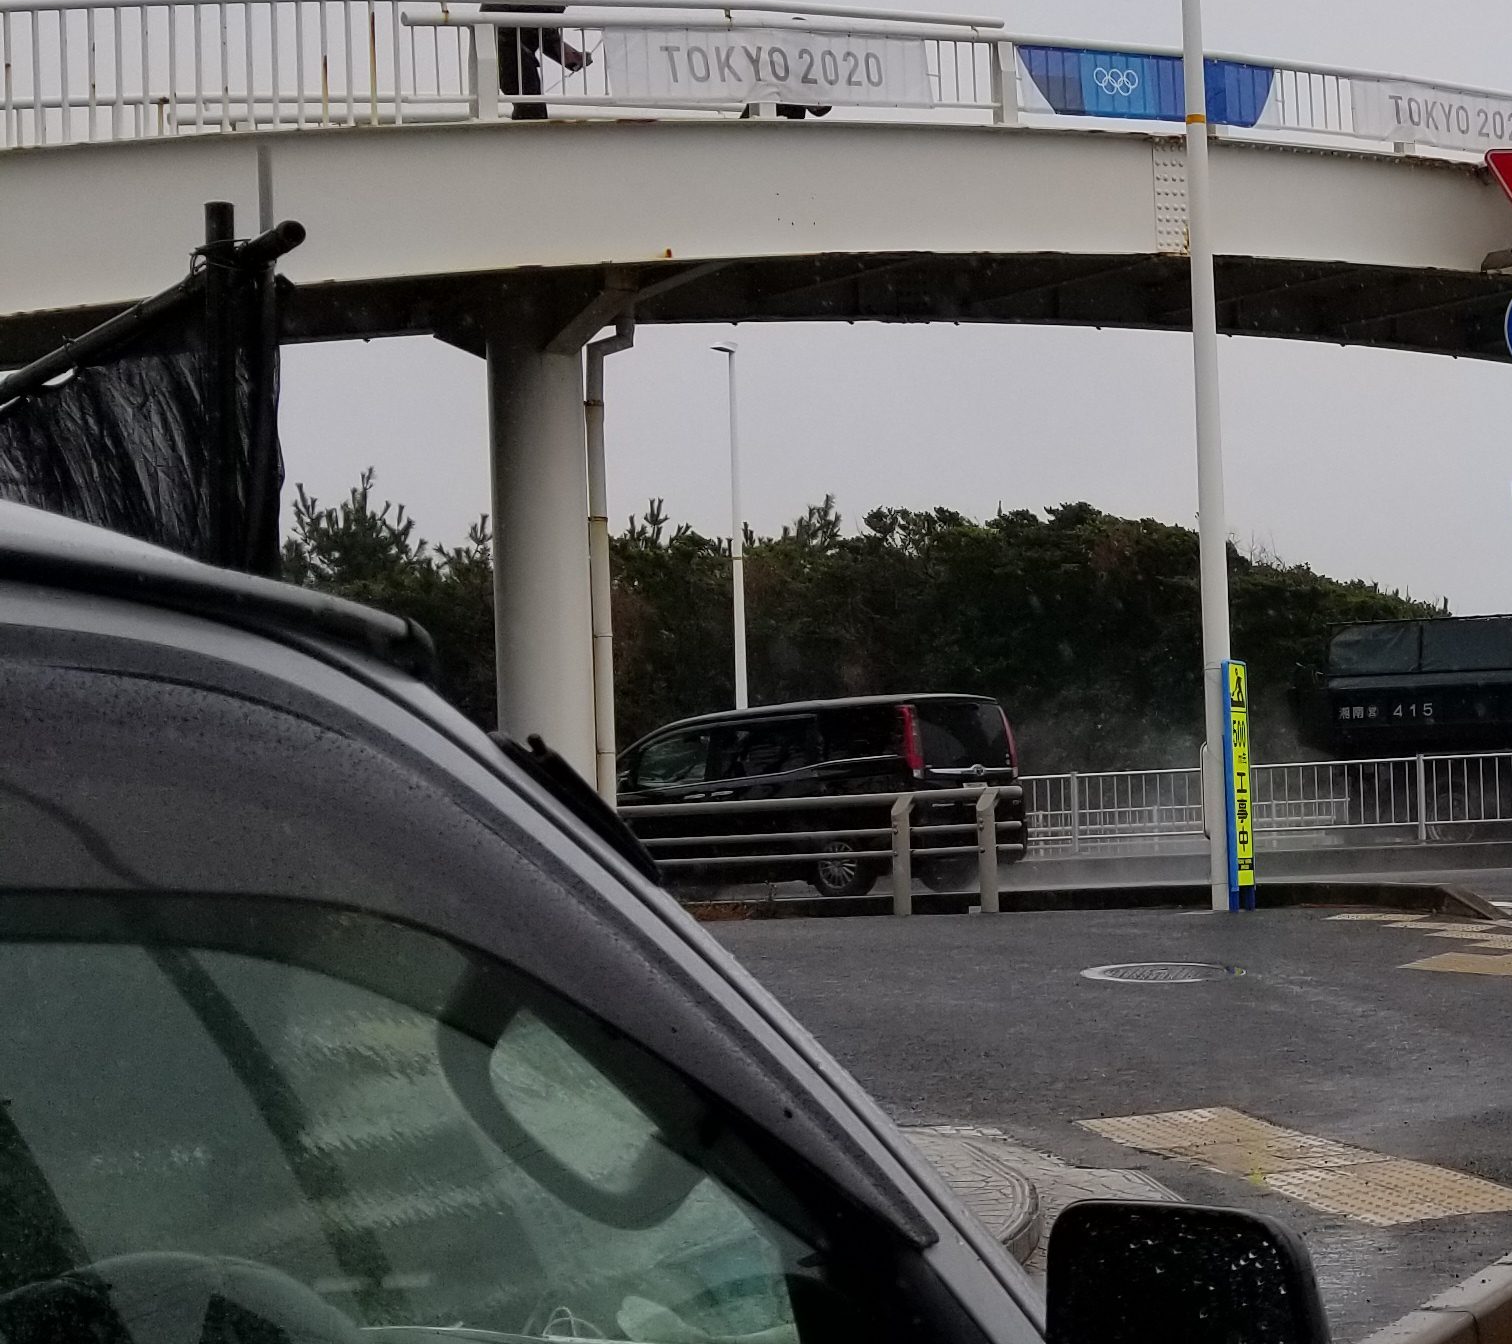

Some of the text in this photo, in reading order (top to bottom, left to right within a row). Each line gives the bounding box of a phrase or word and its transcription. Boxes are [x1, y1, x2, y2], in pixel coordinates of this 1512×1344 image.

[660, 45, 883, 87] TOKYO 2020
[1389, 95, 1470, 135] TOKYO
[1393, 702, 1433, 718] 415
[1236, 771, 1249, 852] 工事中
